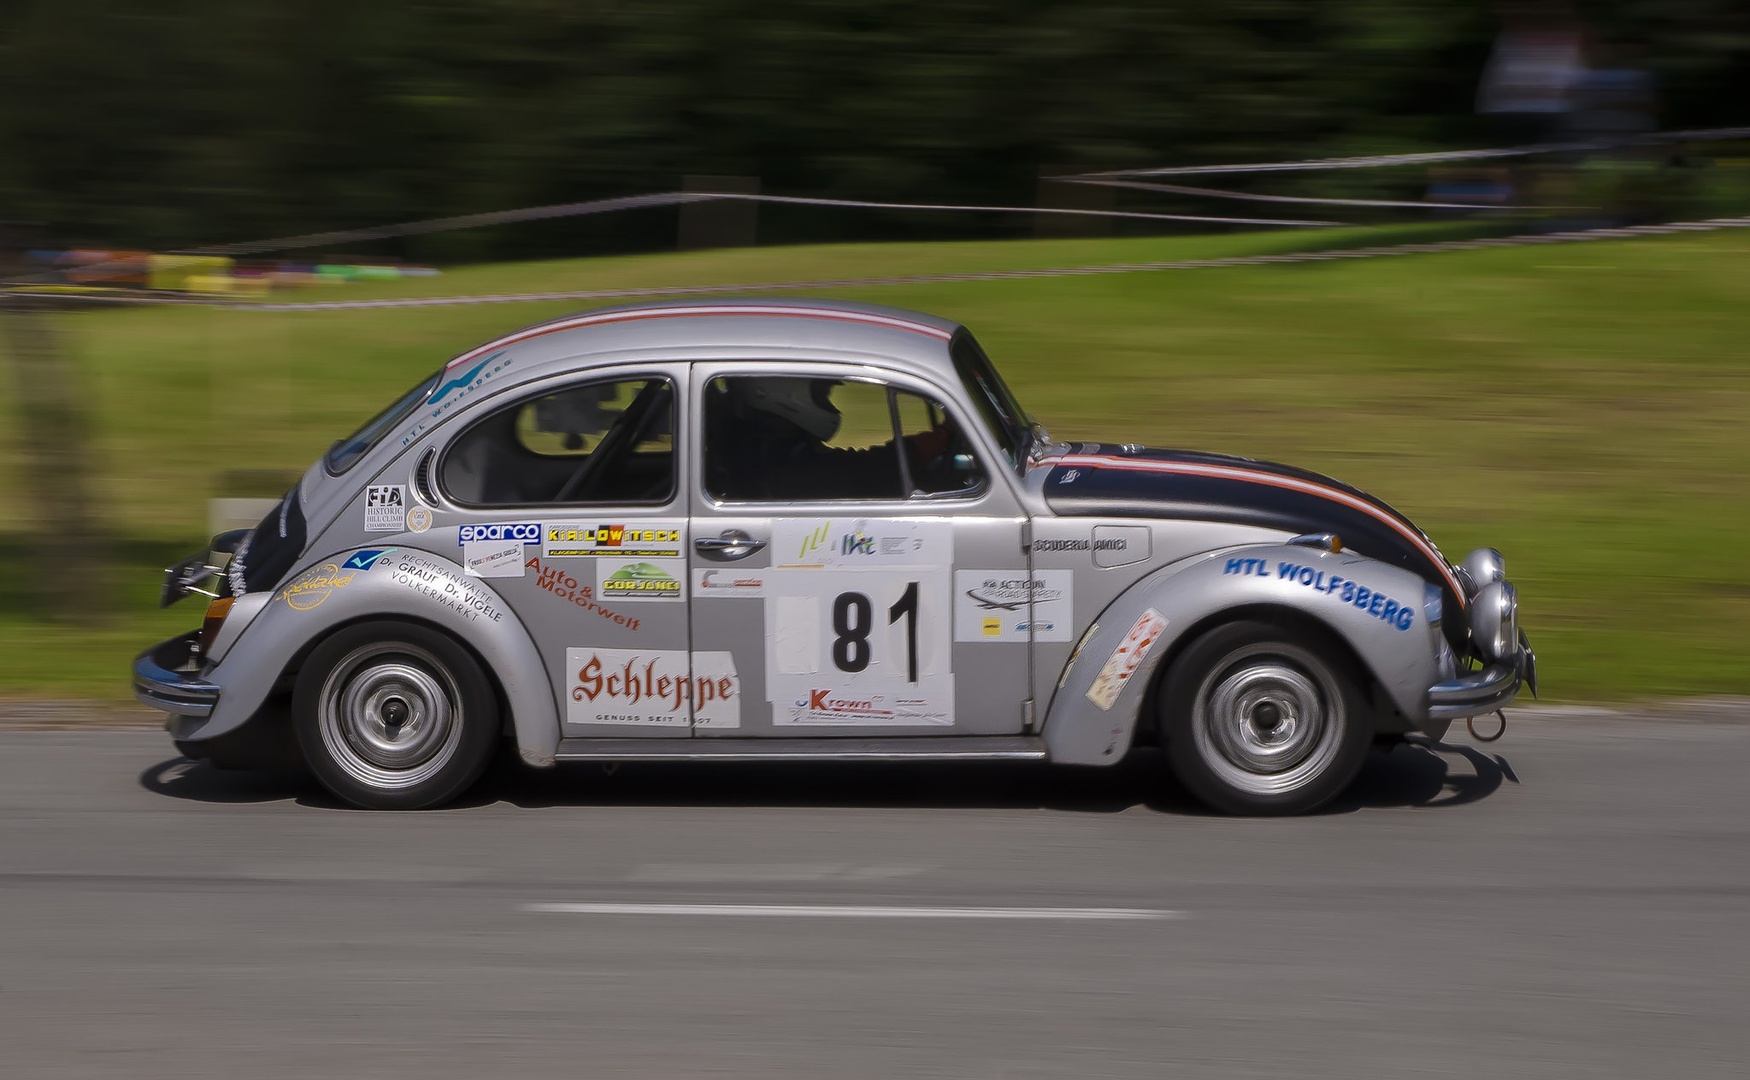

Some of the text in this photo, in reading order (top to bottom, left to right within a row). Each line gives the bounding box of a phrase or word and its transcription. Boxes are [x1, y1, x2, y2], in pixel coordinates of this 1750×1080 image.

[402, 424, 425, 446] HTL
[367, 507, 403, 515] HISTORIC
[460, 525, 539, 542] sparco
[1033, 539, 1127, 551] SCUDERIA AMICI
[391, 570, 481, 622] VÖLKERMARKT
[401, 553, 493, 603] RECHTSANWÄLTE
[525, 556, 578, 589] Auto
[580, 586, 592, 599] &
[1223, 557, 1416, 631] HTL WOLFSBERG
[444, 583, 460, 598] Dr.
[464, 592, 503, 622] VIGELE
[535, 575, 641, 632] Motorwelt
[831, 581, 920, 683] 81
[572, 653, 734, 712] Schleppe
[809, 689, 873, 710] Krown
[596, 714, 712, 724] GENUSS SEIT 107
